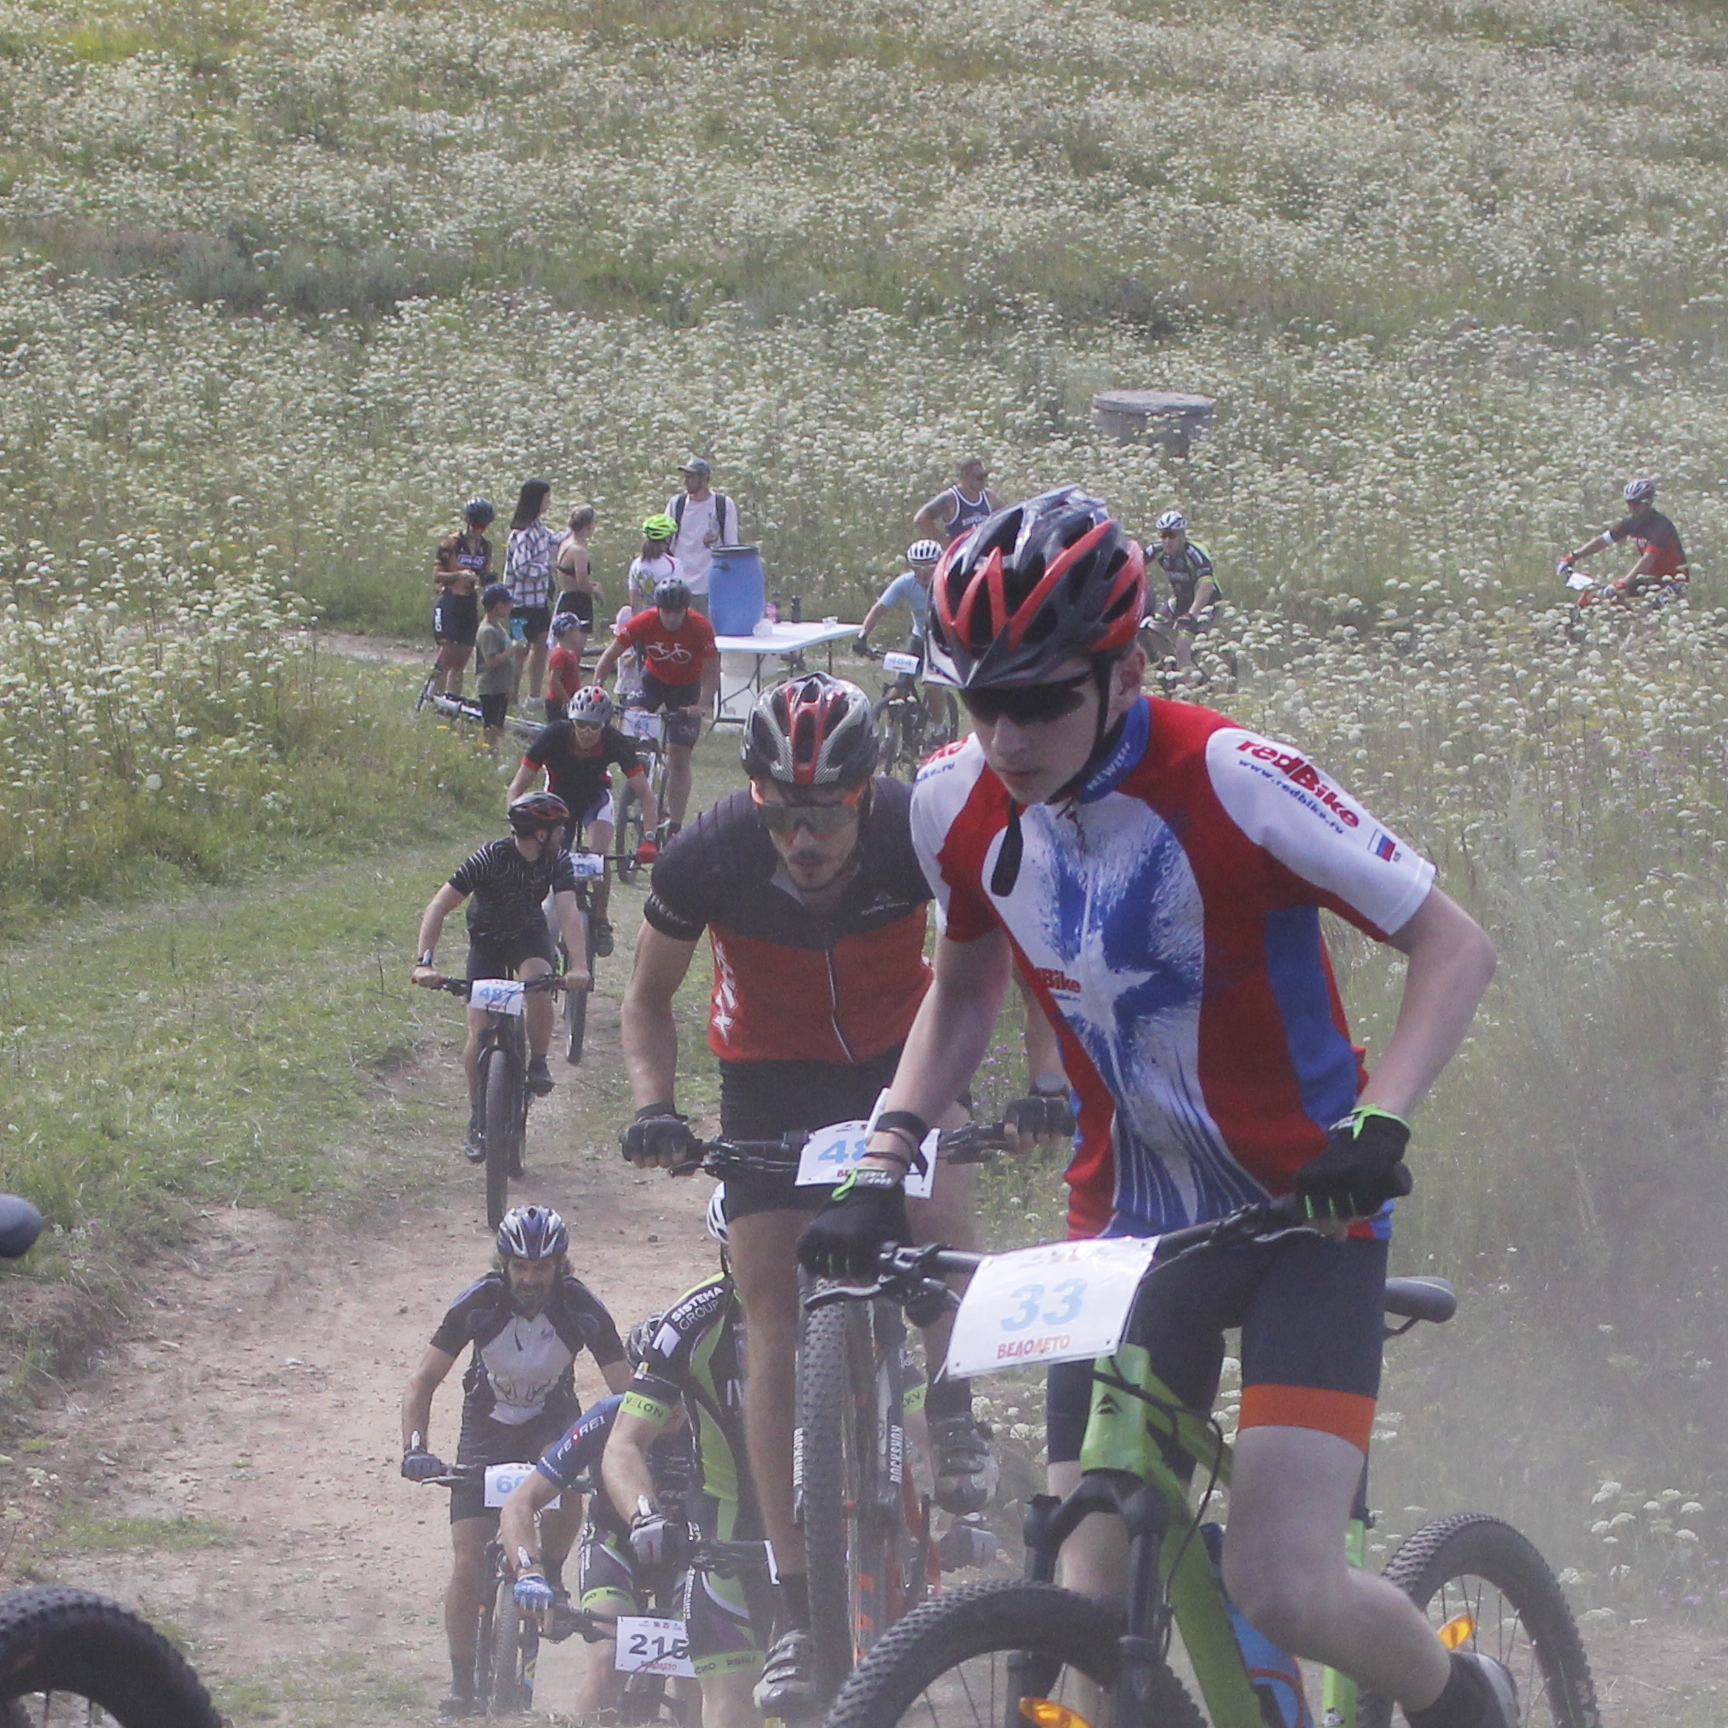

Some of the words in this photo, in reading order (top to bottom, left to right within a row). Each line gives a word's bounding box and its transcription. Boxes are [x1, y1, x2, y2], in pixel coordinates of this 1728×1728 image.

[671, 1286, 724, 1323] SISTEMA
[678, 1300, 720, 1331] GROUP
[1001, 1277, 1088, 1331] 33
